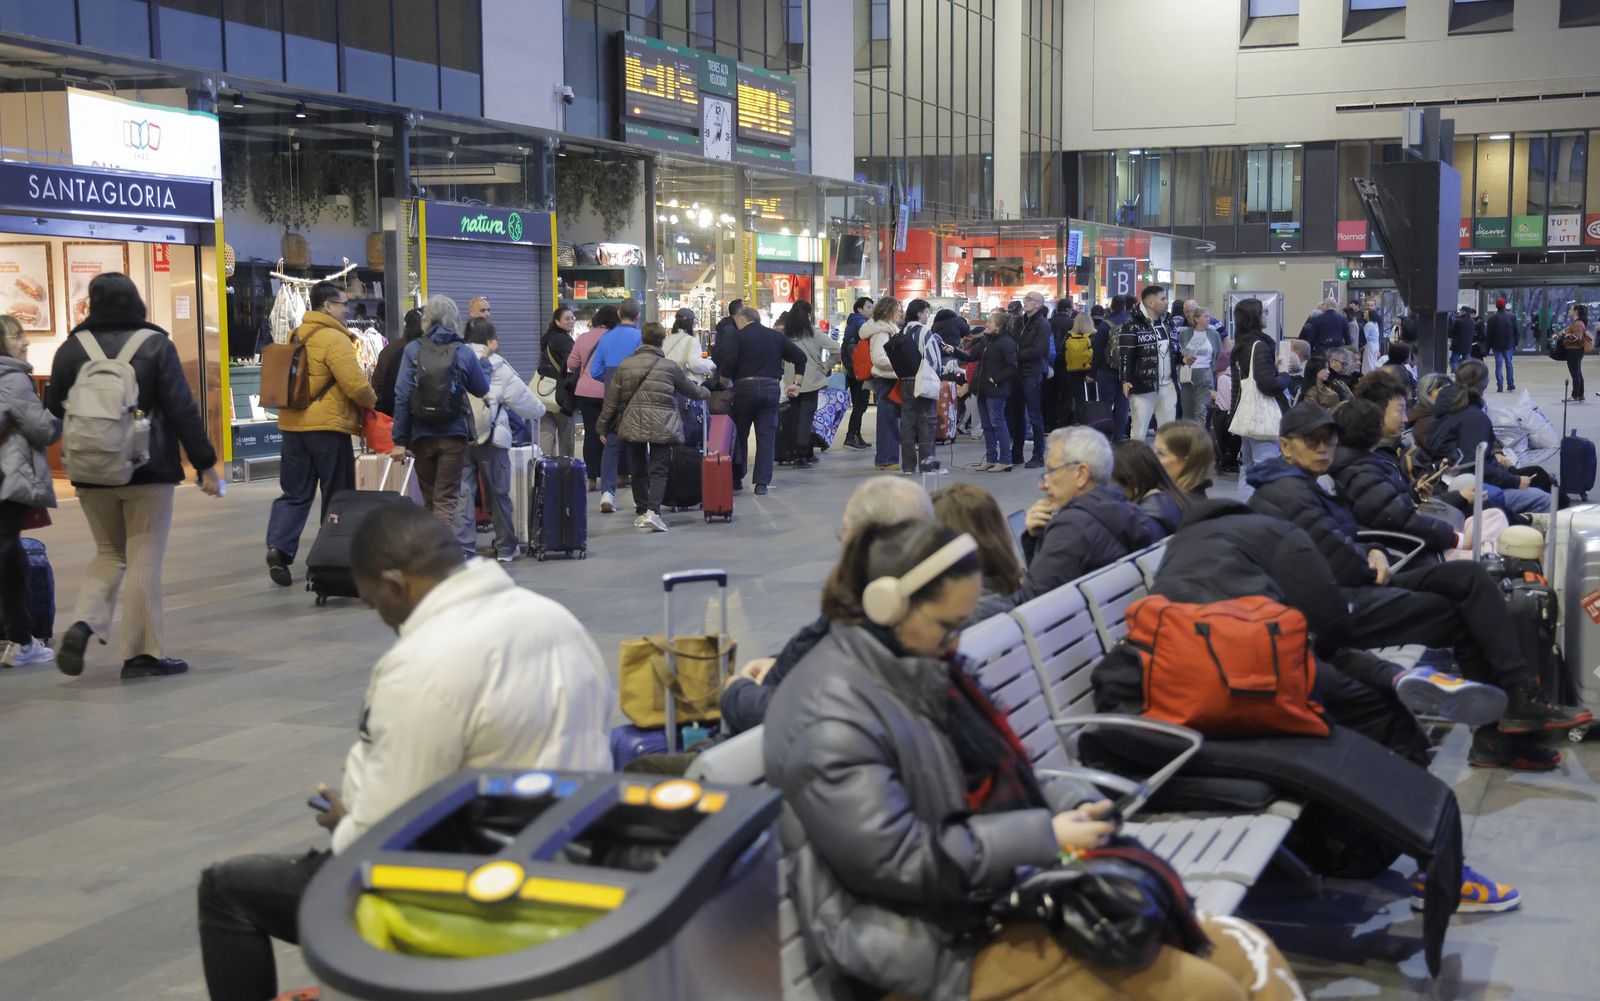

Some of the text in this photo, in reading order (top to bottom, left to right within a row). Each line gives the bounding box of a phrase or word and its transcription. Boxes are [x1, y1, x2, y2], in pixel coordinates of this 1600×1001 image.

[709, 73, 728, 88] VELOCIDAD
[28, 174, 177, 209] SANTAGLORIA
[460, 213, 507, 236] natura
[1475, 223, 1505, 235] discover
[1336, 232, 1367, 241] flormar
[774, 278, 790, 297] 19
[1117, 271, 1129, 296] B
